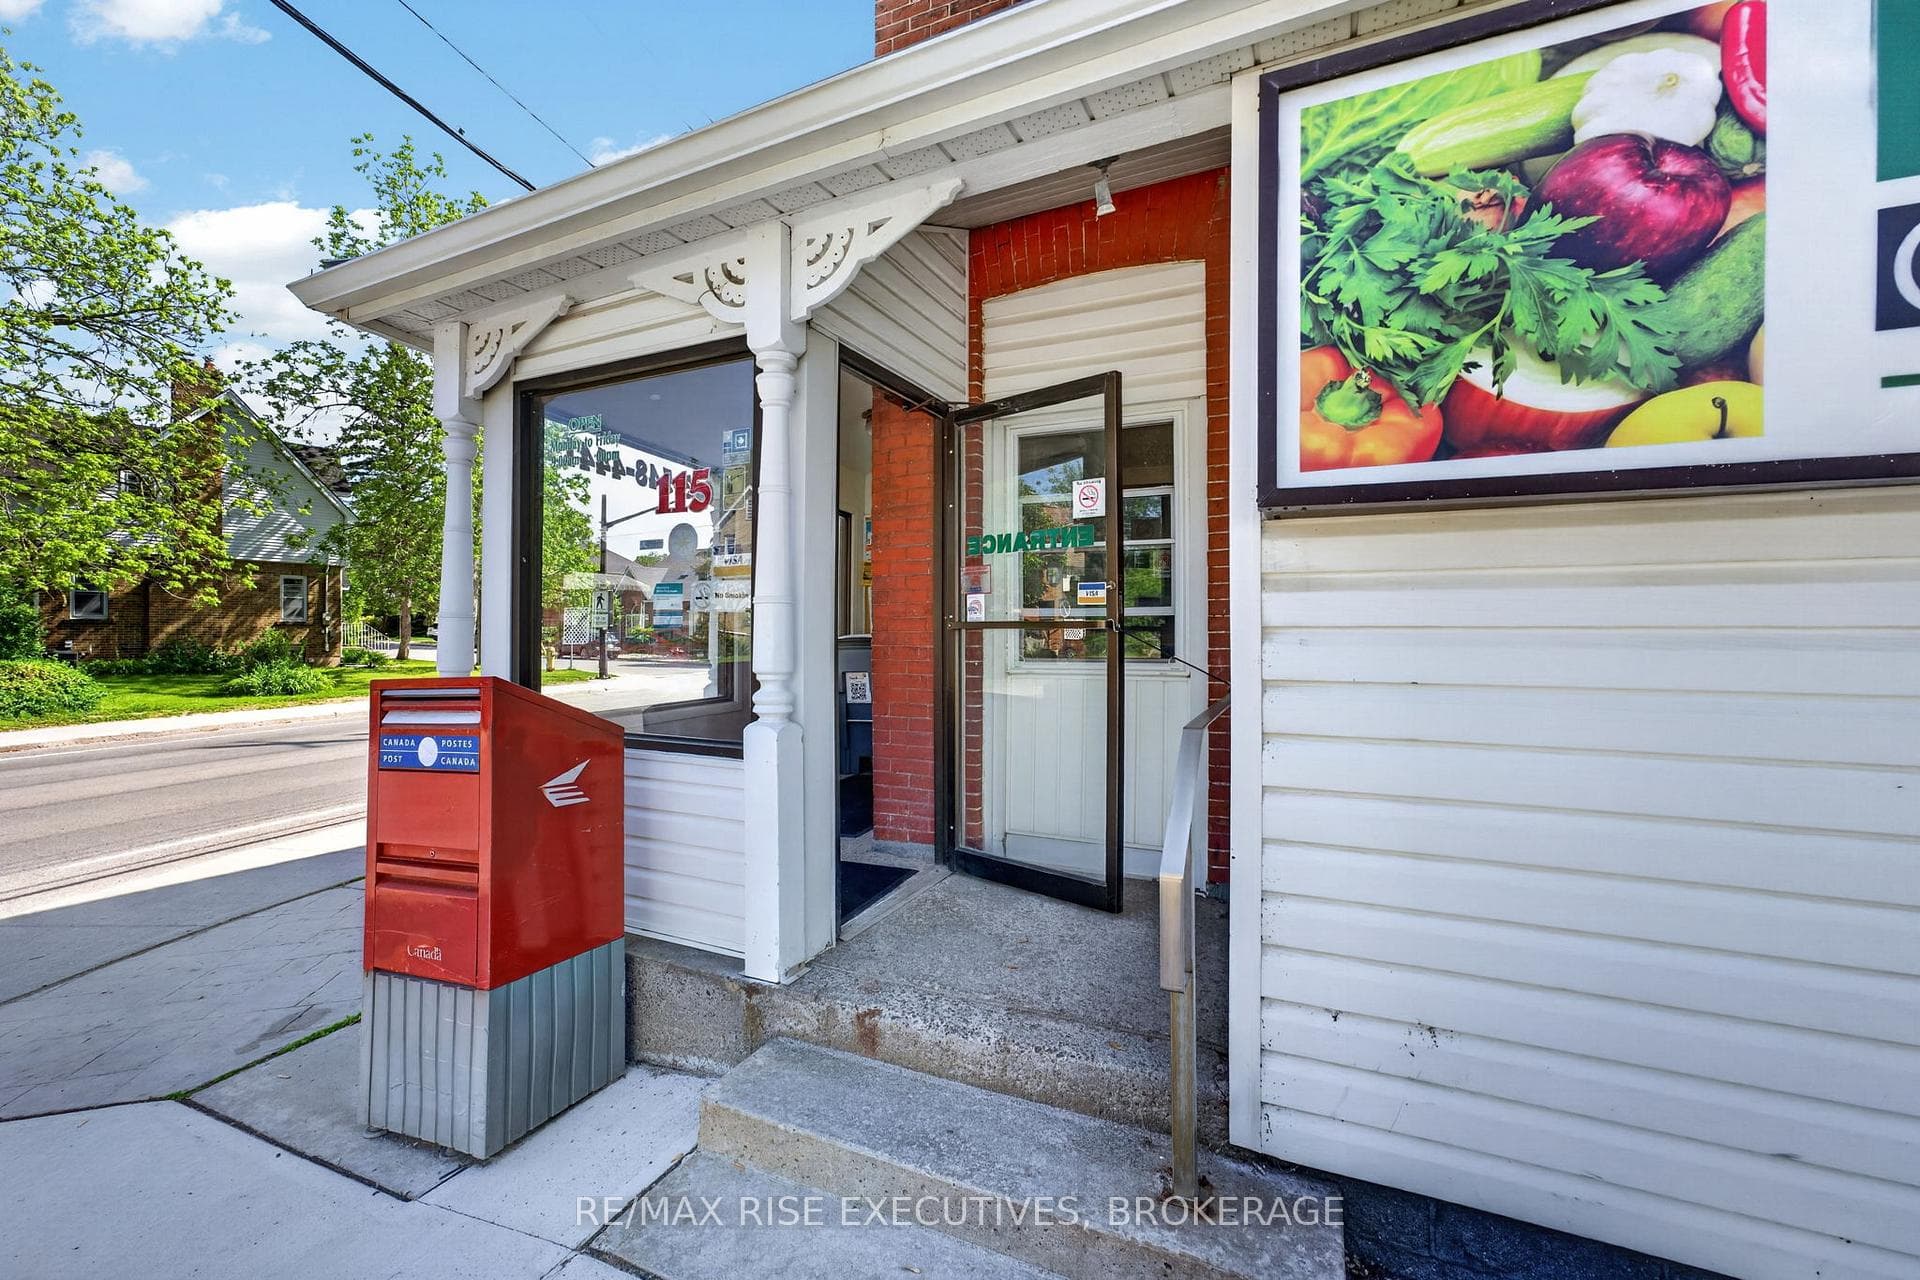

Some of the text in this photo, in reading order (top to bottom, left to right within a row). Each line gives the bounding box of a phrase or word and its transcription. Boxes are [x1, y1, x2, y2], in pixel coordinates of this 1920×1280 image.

[568, 414, 602, 432] OPEN
[595, 432, 621, 447] Friday
[655, 467, 713, 514] 115
[724, 555, 743, 565] VISA
[383, 738, 416, 747] CANADA
[441, 739, 473, 748] POSTES
[383, 755, 403, 763] POST
[440, 756, 476, 766] CANADA
[407, 945, 442, 960] Canada
